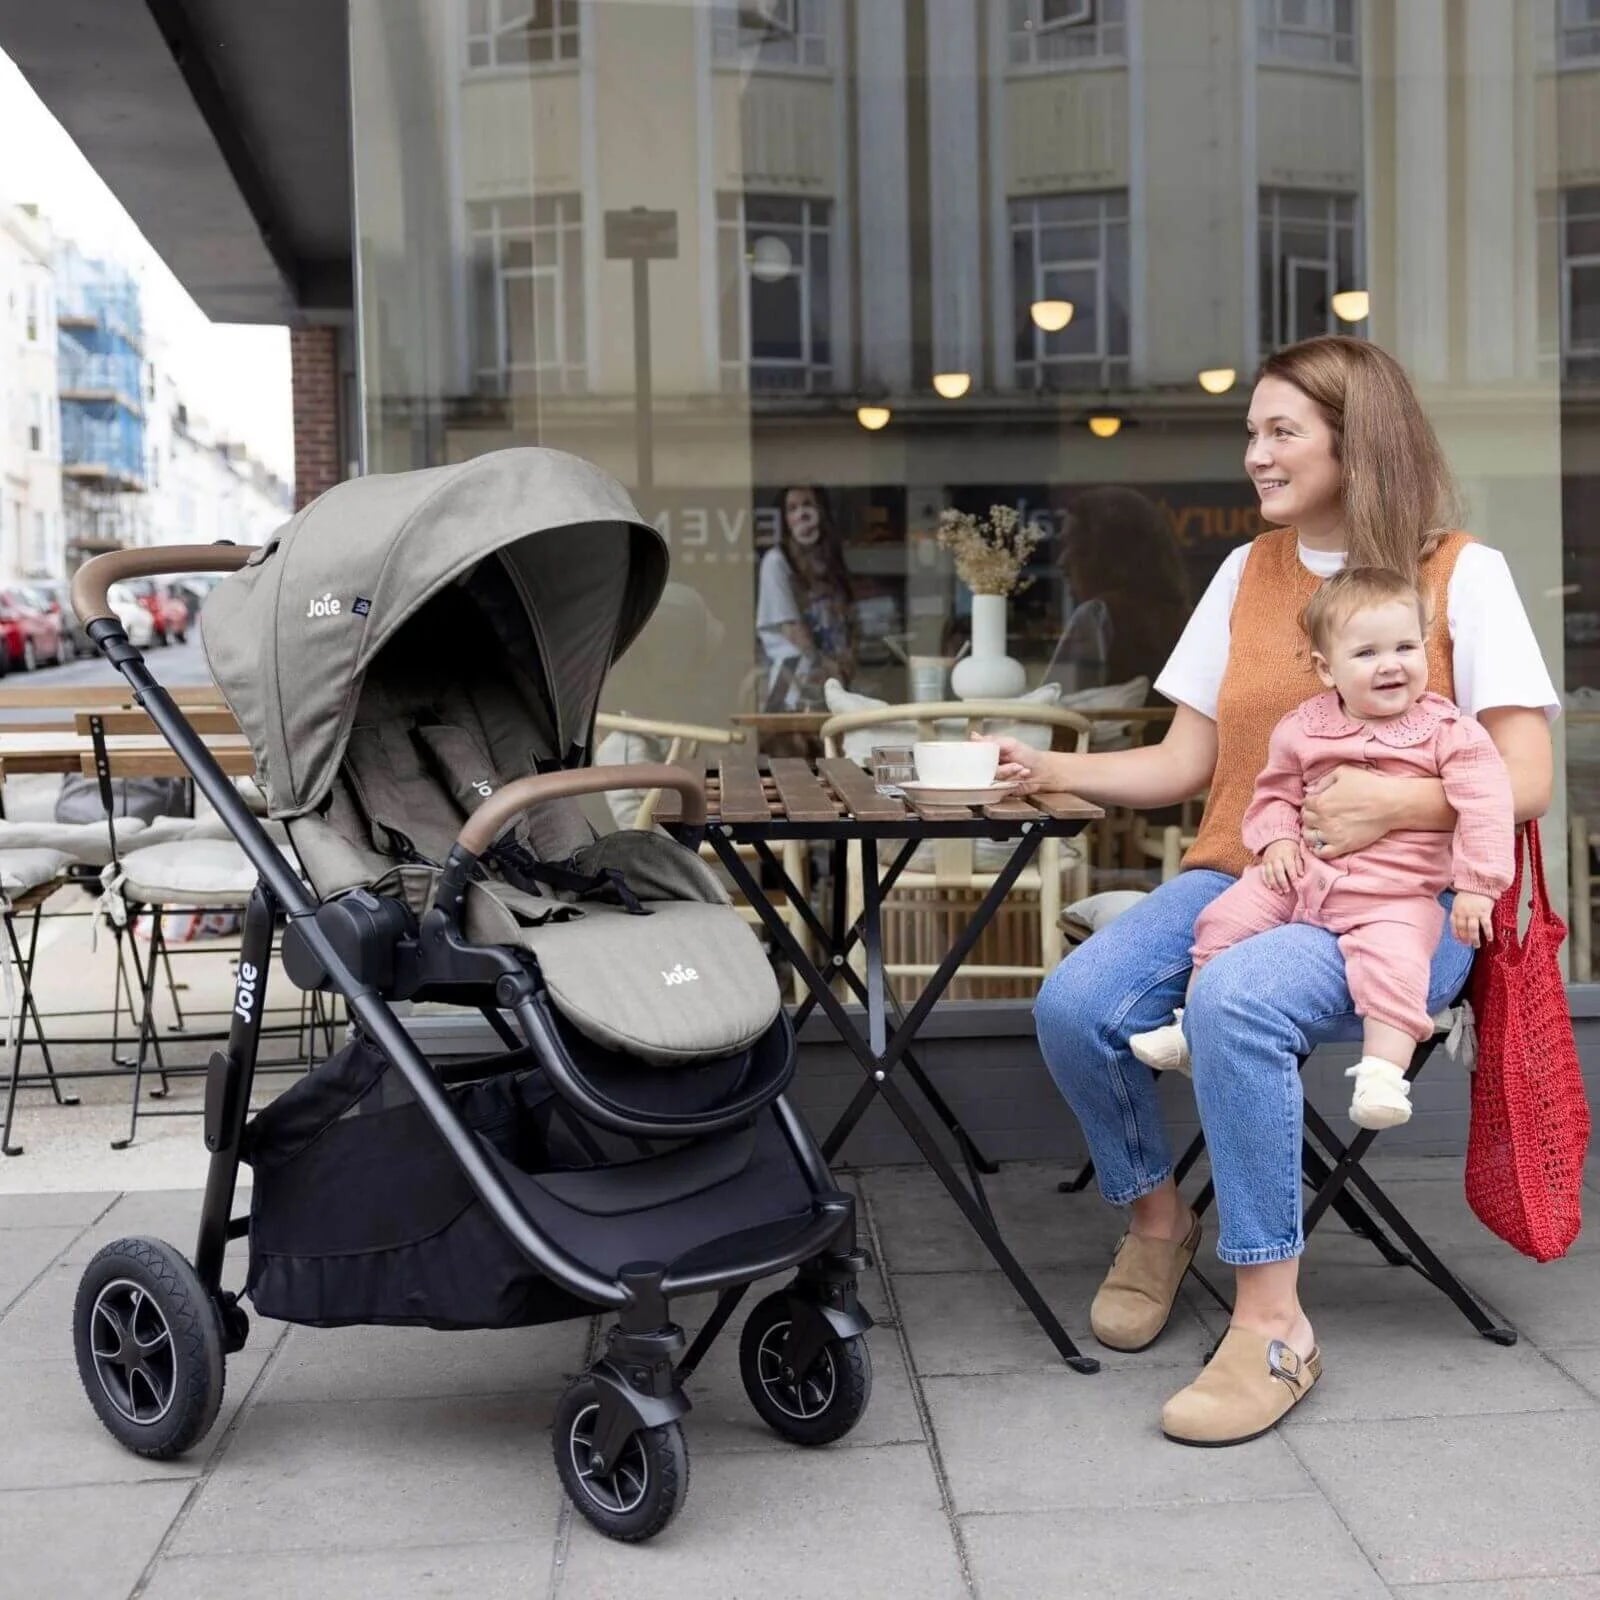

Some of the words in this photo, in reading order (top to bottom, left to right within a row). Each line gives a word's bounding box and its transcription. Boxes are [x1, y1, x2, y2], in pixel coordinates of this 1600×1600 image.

[306, 592, 341, 618] Joie
[471, 780, 493, 798] Jo
[660, 963, 699, 987] Joie
[235, 962, 258, 1024] Joie
